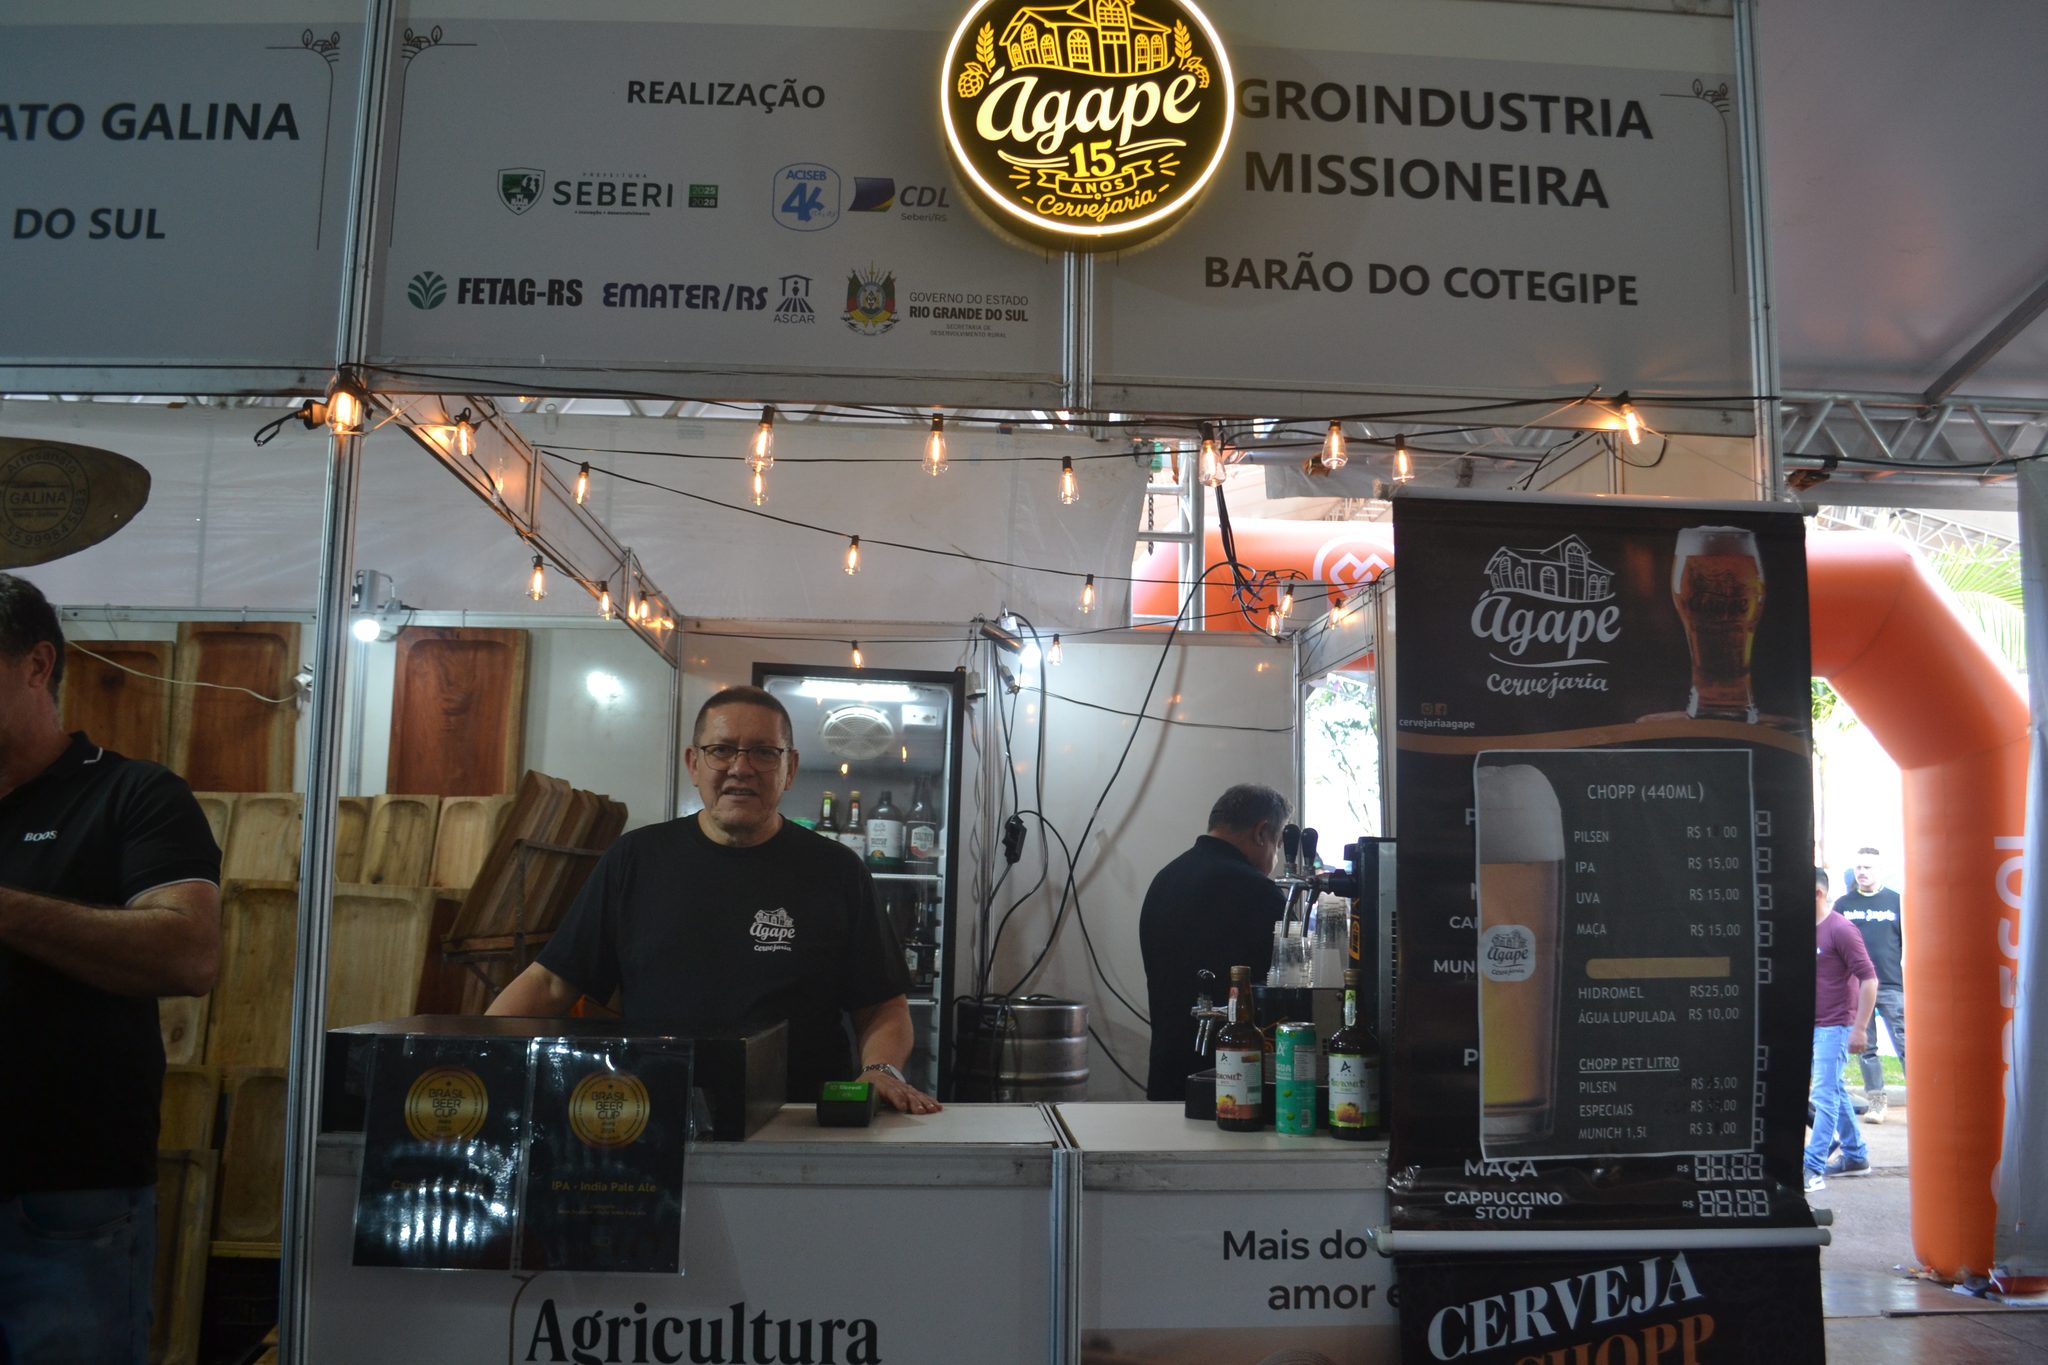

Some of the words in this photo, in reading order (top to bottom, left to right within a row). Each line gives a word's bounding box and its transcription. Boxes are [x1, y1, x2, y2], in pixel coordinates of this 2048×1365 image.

[627, 78, 826, 114] REALIZAÇÃO
[976, 66, 1200, 155] Ágape
[1235, 78, 1654, 140] GROINDUSTRIA
[102, 103, 300, 141] GALINA
[1069, 139, 1116, 178] 15
[785, 169, 827, 181] ACISEB
[1245, 151, 1610, 209] MISSIONEIRA
[1070, 178, 1125, 193] ANOS
[552, 180, 673, 208] SEBERI
[900, 186, 950, 208] CDL
[1036, 189, 1158, 222] Cervejaria
[13, 208, 76, 240] DO
[88, 208, 166, 240] SUL
[901, 212, 948, 222] Seberi/RS
[1204, 251, 1353, 294] BARÃO
[1368, 263, 1430, 297] DO
[1443, 266, 1639, 306] COTEGIPE
[457, 277, 583, 307] FETAG-RS
[602, 283, 768, 311] EMATER/RS
[909, 291, 963, 304] GOVERNO
[966, 293, 982, 305] DO
[985, 294, 1029, 306] ESTADO
[773, 313, 815, 324] ASCAR
[909, 305, 930, 319] RIO
[932, 306, 982, 320] GRANDE
[984, 308, 1002, 321] DO
[1004, 308, 1029, 322] SUL
[10, 491, 65, 504] GALINA
[1471, 589, 1622, 659] Ágape
[1486, 671, 1609, 699] Cervejaria
[1587, 784, 1636, 800] CHOPP
[1641, 781, 1704, 803] (440ML)
[1573, 830, 1610, 843] PILSEN
[1575, 861, 1596, 873] IPA
[1576, 892, 1600, 904] UVA
[1578, 986, 1645, 1000] HIDROMEL
[1578, 1008, 1610, 1024] ÁGUA
[1612, 1010, 1677, 1024] LUPULADA
[1579, 1057, 1618, 1071] CHOPP
[1621, 1057, 1643, 1070] PET
[1646, 1056, 1680, 1069] LITRO
[429, 1088, 466, 1099] BRASIL
[1579, 1081, 1617, 1094] PILSEN
[432, 1098, 462, 1108] BEER
[592, 1091, 628, 1102] BRASIL
[434, 1108, 457, 1118] CUP
[596, 1101, 624, 1111] BEER
[1579, 1104, 1633, 1117] ESPECIAIS
[597, 1110, 620, 1120] CUP
[1578, 1127, 1622, 1140] MUNICH
[552, 1180, 571, 1191] IPA
[580, 1180, 608, 1192] India
[610, 1181, 635, 1192] Pale
[637, 1182, 657, 1193] Ale
[1443, 1190, 1563, 1207] CAPPUCCINO
[1475, 1205, 1534, 1221] STOUT
[1223, 1228, 1310, 1261] Mais
[1319, 1229, 1368, 1260] do
[1267, 1283, 1376, 1311] amor
[1427, 1250, 1704, 1362] CERVEJA
[524, 1298, 883, 1365] Agricultura
